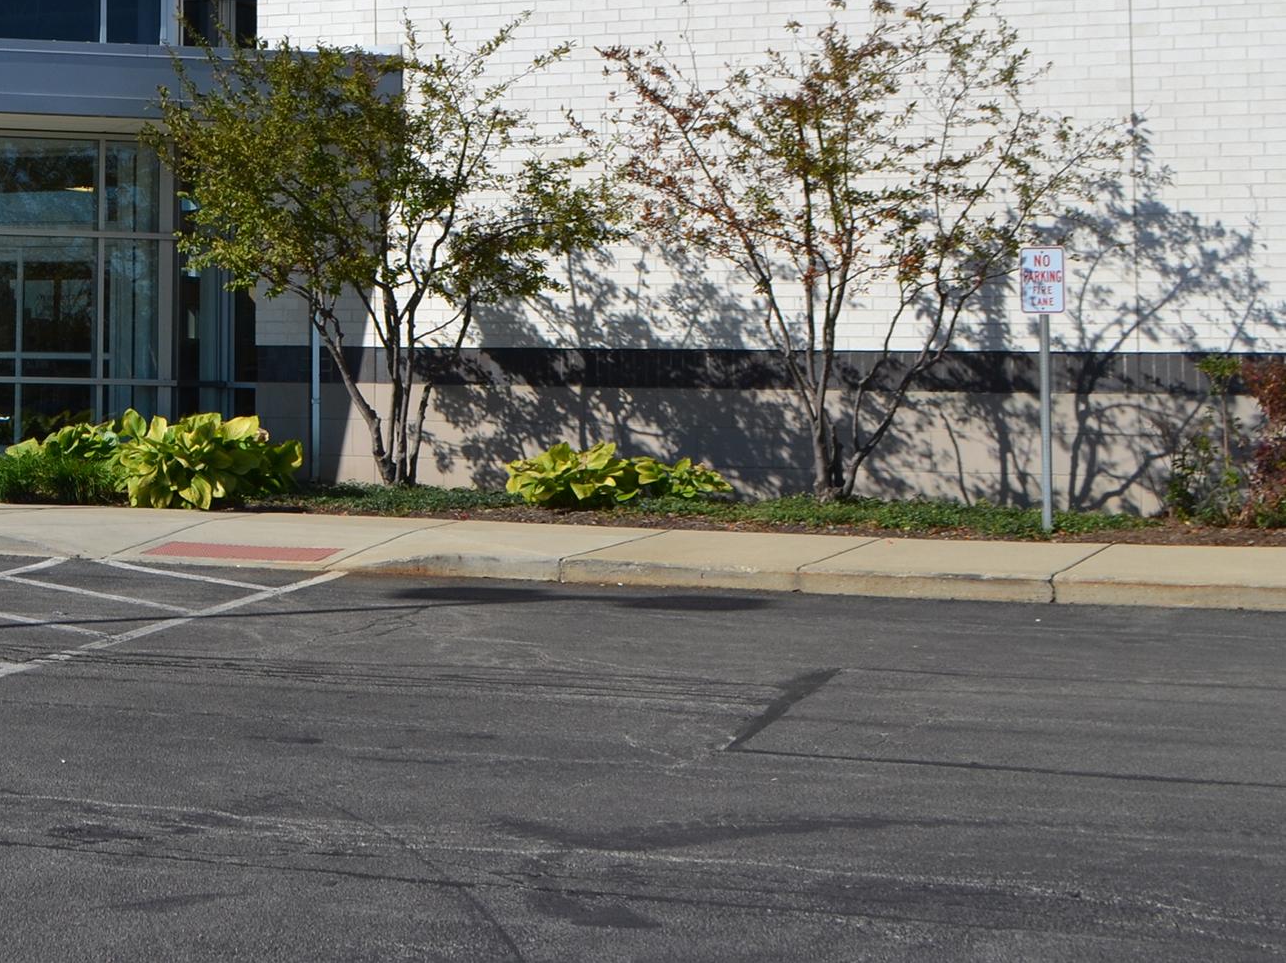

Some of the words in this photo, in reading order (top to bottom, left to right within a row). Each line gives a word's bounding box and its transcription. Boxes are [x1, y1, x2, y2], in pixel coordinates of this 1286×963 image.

[1034, 255, 1050, 267] NO
[1023, 270, 1062, 283] PARKING
[1033, 285, 1053, 295] FIRE
[1031, 297, 1055, 307] LANE
